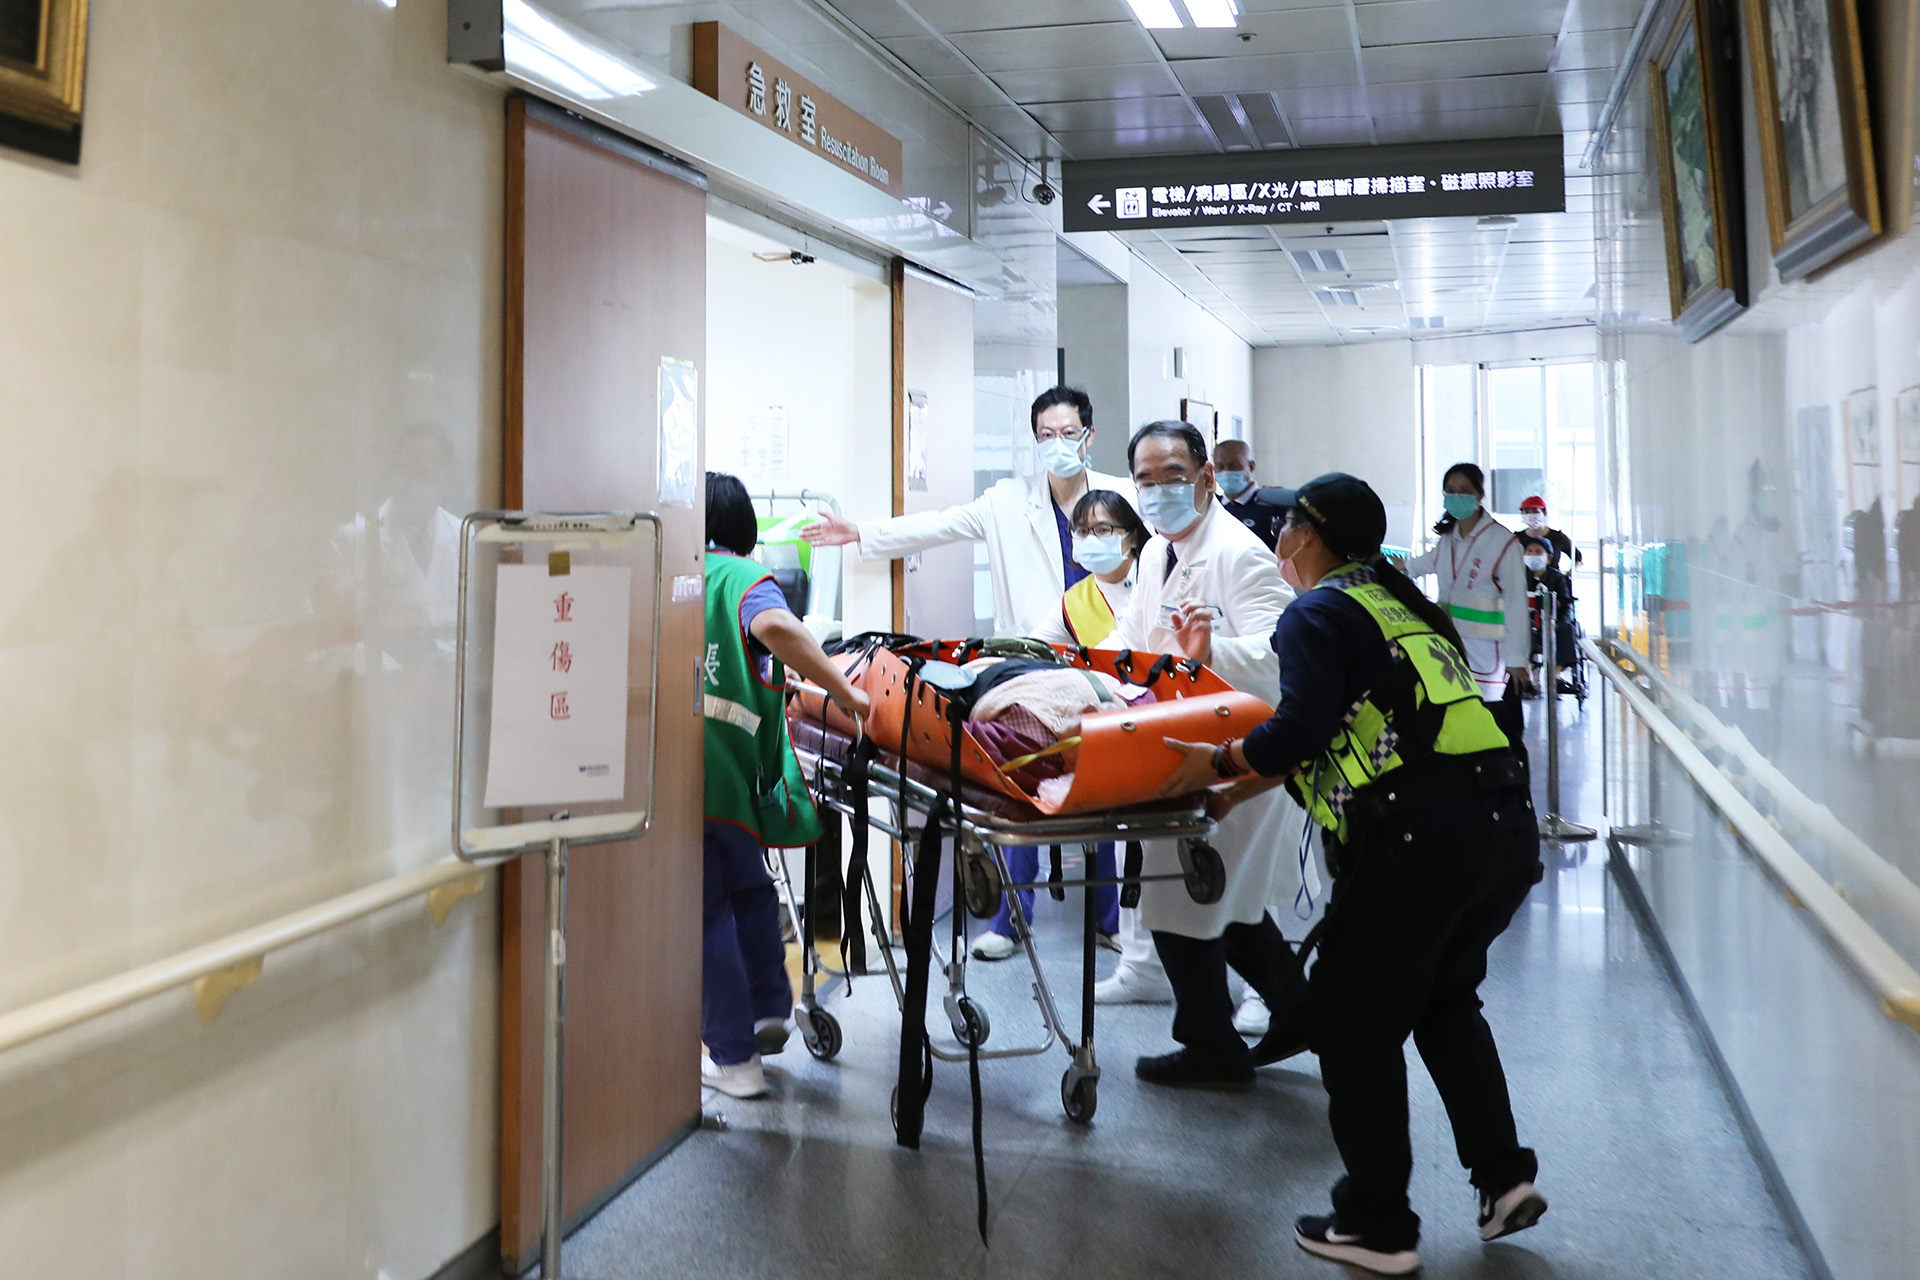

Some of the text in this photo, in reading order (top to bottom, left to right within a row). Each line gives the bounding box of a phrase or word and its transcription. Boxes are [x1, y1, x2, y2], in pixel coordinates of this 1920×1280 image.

[748, 62, 816, 145] 急救室
[820, 126, 890, 186] Resuscitation Room
[1152, 207, 1192, 218] Elevator
[1201, 205, 1228, 216] Ward
[1237, 203, 1267, 215] X-Ray
[549, 591, 575, 720] 重傷區
